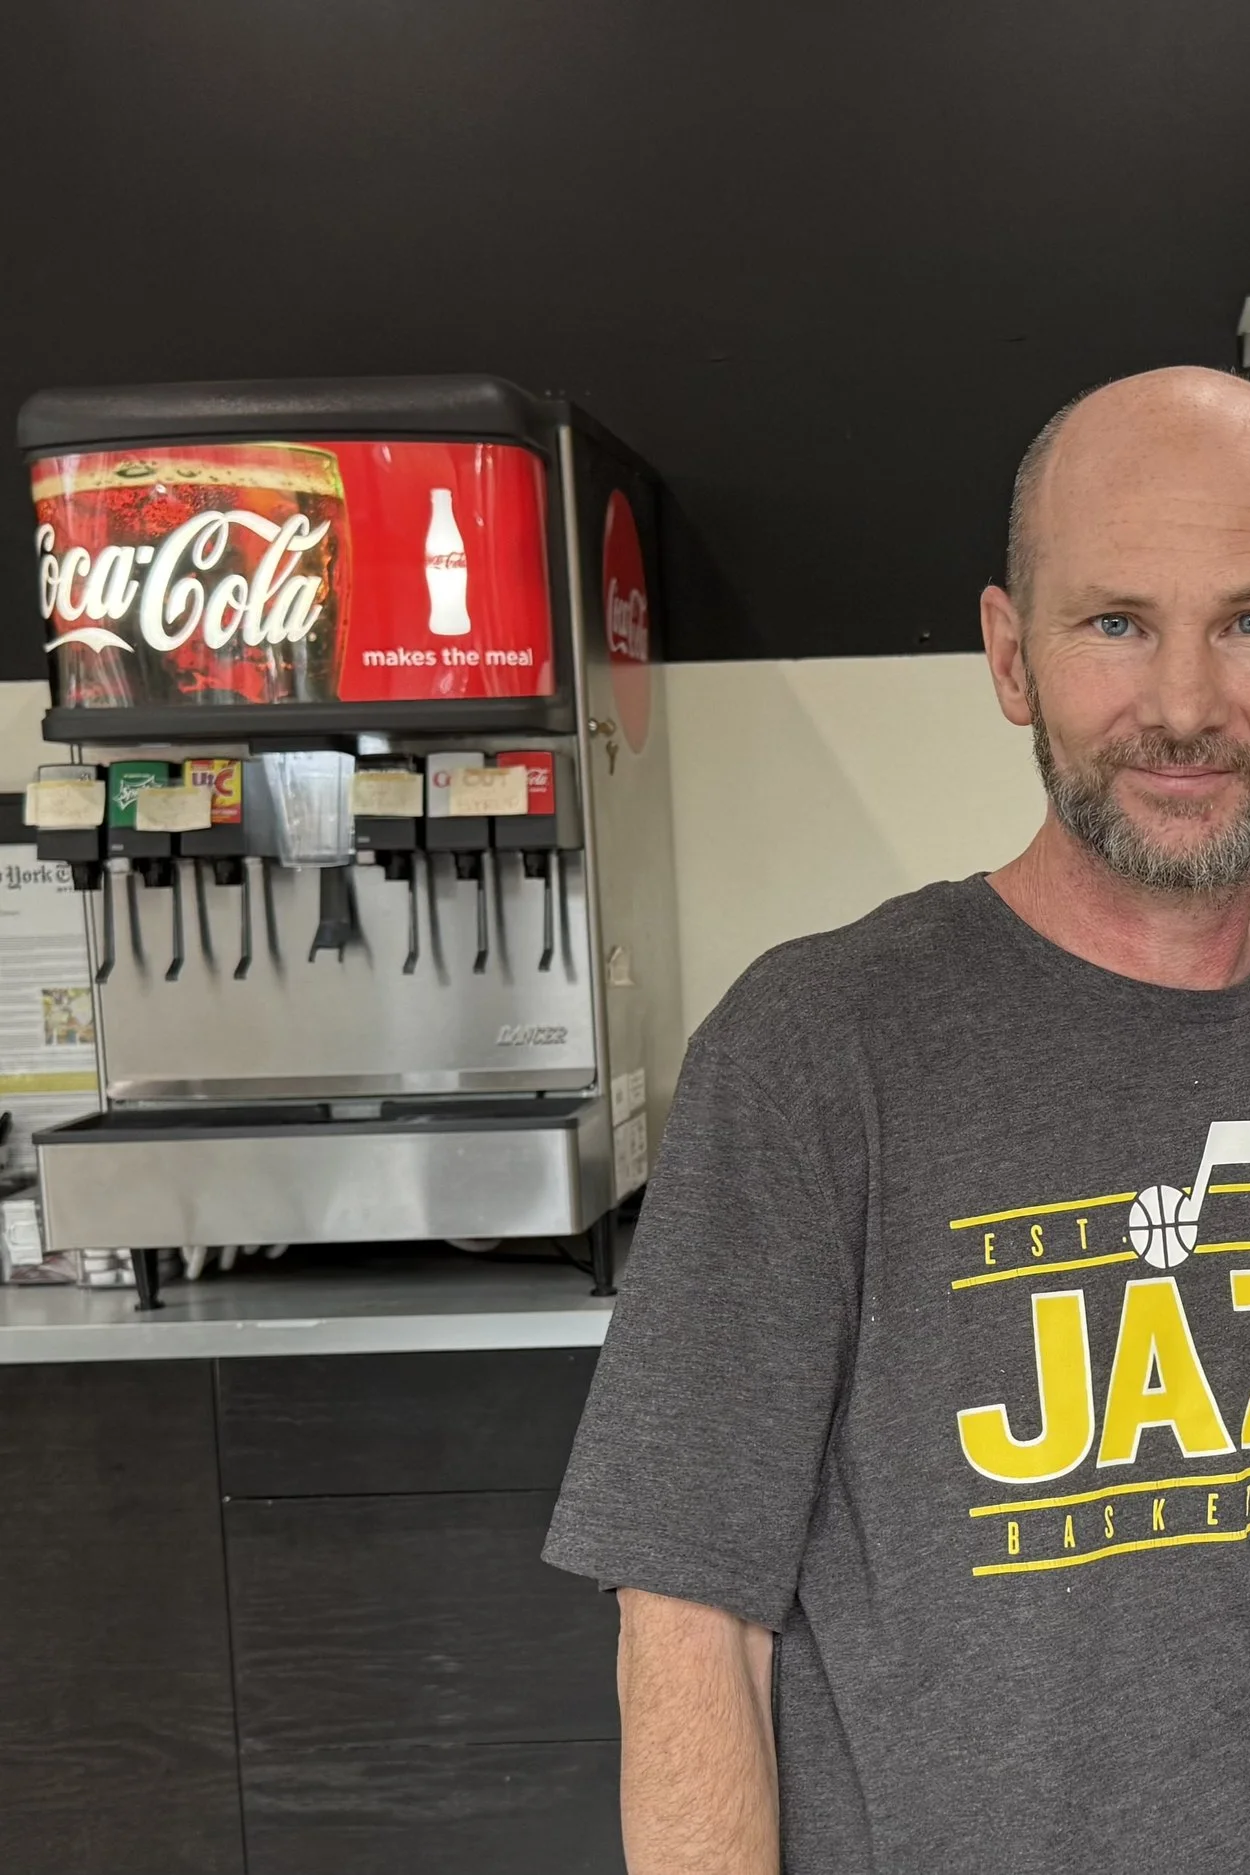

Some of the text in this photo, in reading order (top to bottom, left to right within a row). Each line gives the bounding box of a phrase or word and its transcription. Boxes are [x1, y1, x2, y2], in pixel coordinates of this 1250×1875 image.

[363, 647, 533, 668] makes the meal
[6, 865, 53, 890] York
